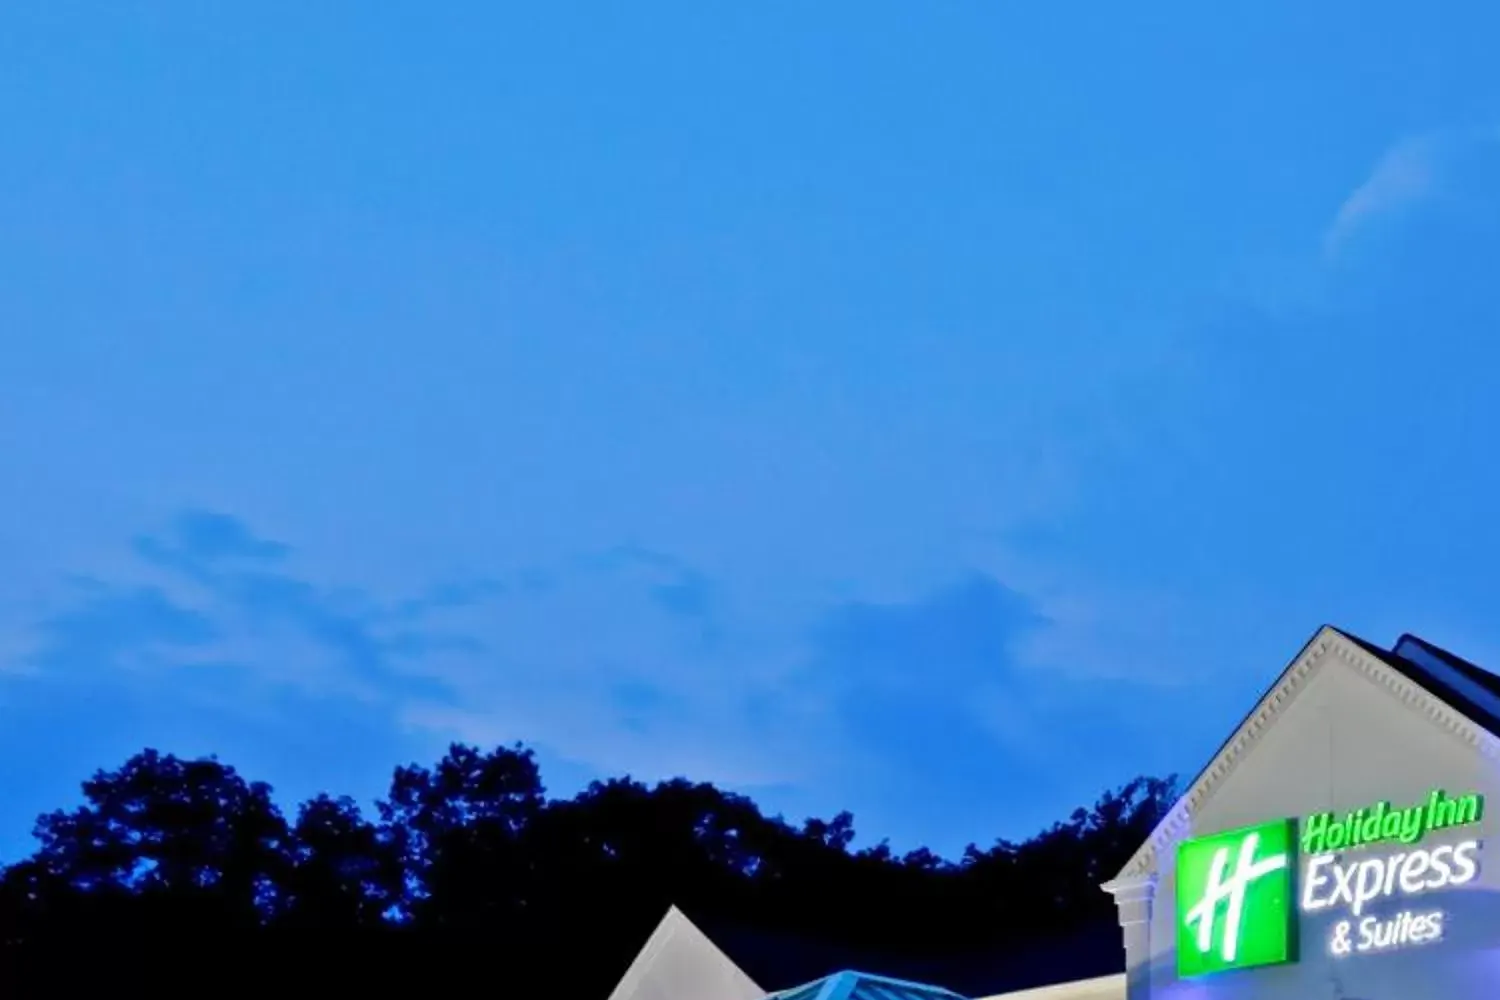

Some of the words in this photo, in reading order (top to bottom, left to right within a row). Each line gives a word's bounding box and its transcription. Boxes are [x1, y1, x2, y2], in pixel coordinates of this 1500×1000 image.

[1302, 801, 1426, 853] Holiday
[1427, 790, 1482, 829] Inn
[1302, 840, 1479, 916] Express
[1331, 919, 1352, 955] &
[1356, 911, 1443, 950] Suites
